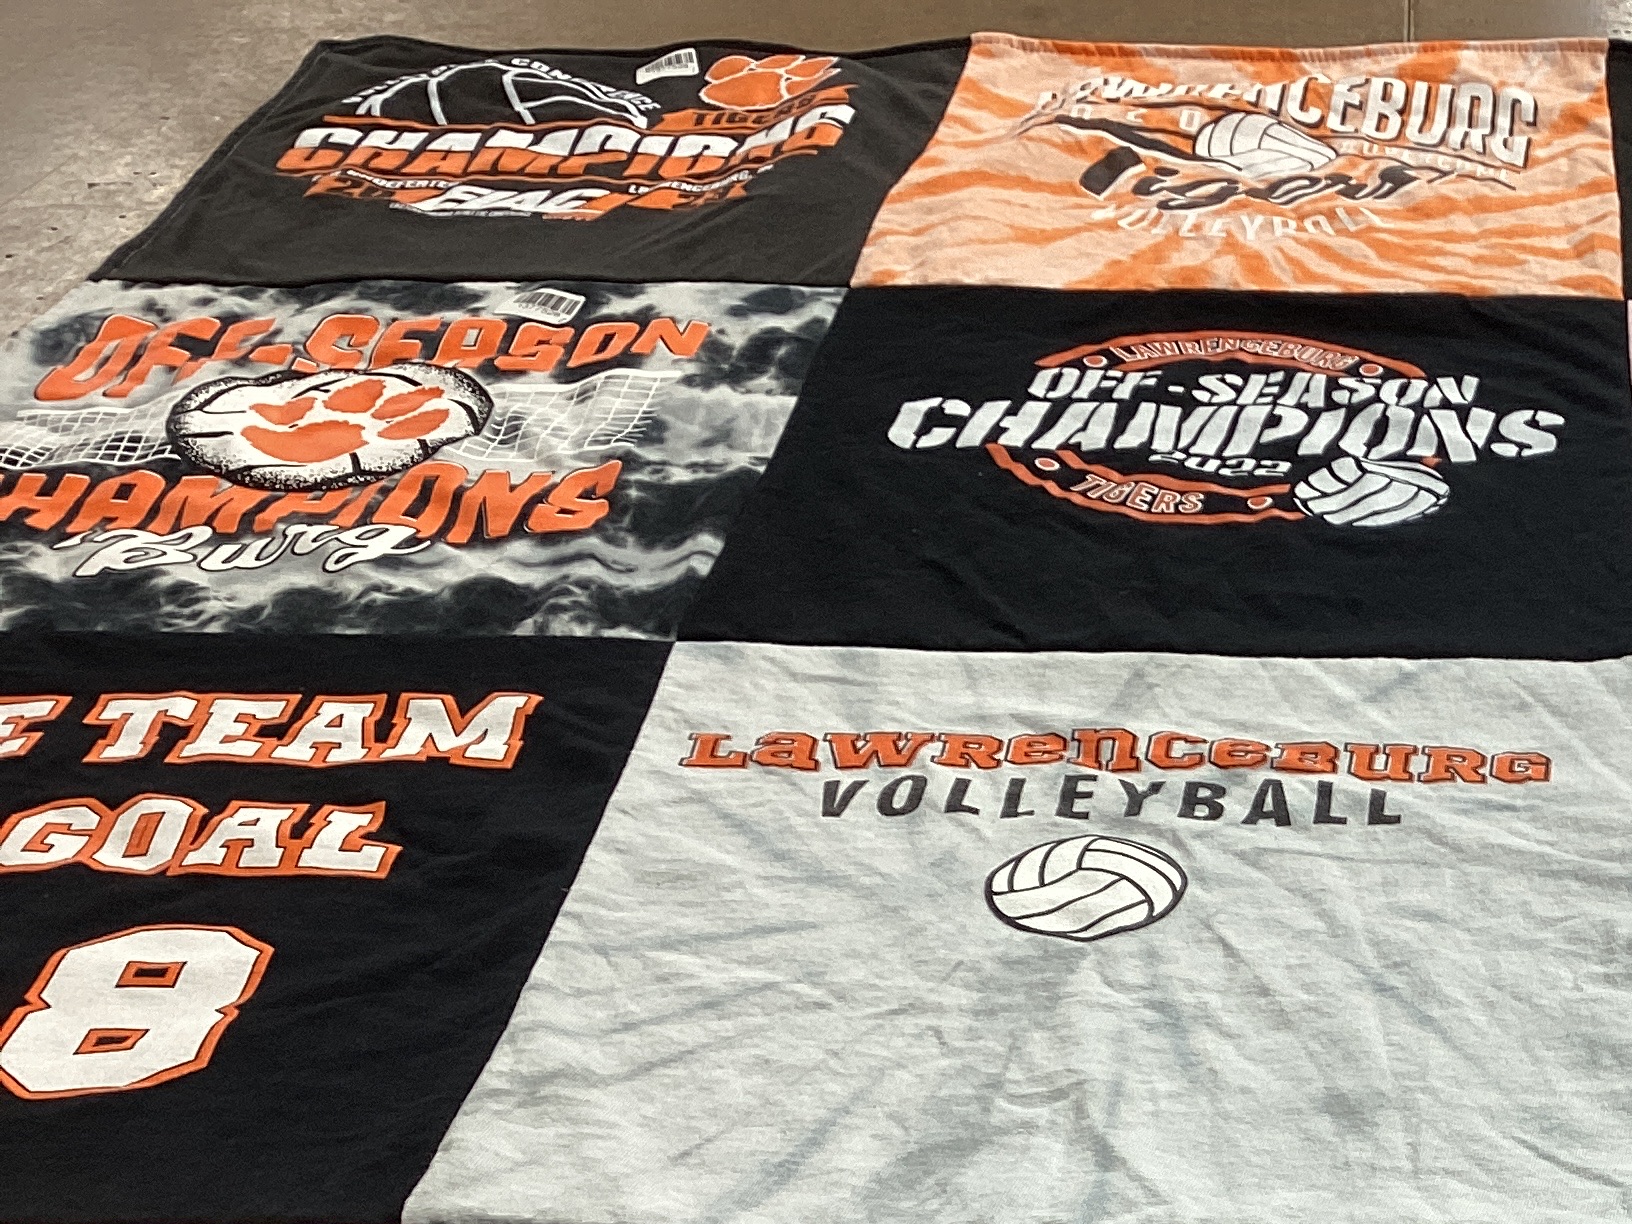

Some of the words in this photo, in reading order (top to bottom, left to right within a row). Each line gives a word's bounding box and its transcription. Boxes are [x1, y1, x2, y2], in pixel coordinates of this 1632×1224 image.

[887, 397, 1565, 463] CHAMPIONS
[1070, 473, 1205, 513] TIGERS
[1148, 452, 1293, 477] 2022
[0, 460, 623, 544] HAMPIONS
[53, 524, 431, 577] Burg
[82, 691, 545, 769] TEAM
[819, 774, 1403, 828] VOLLEYBALL
[0, 793, 404, 880] GOAL
